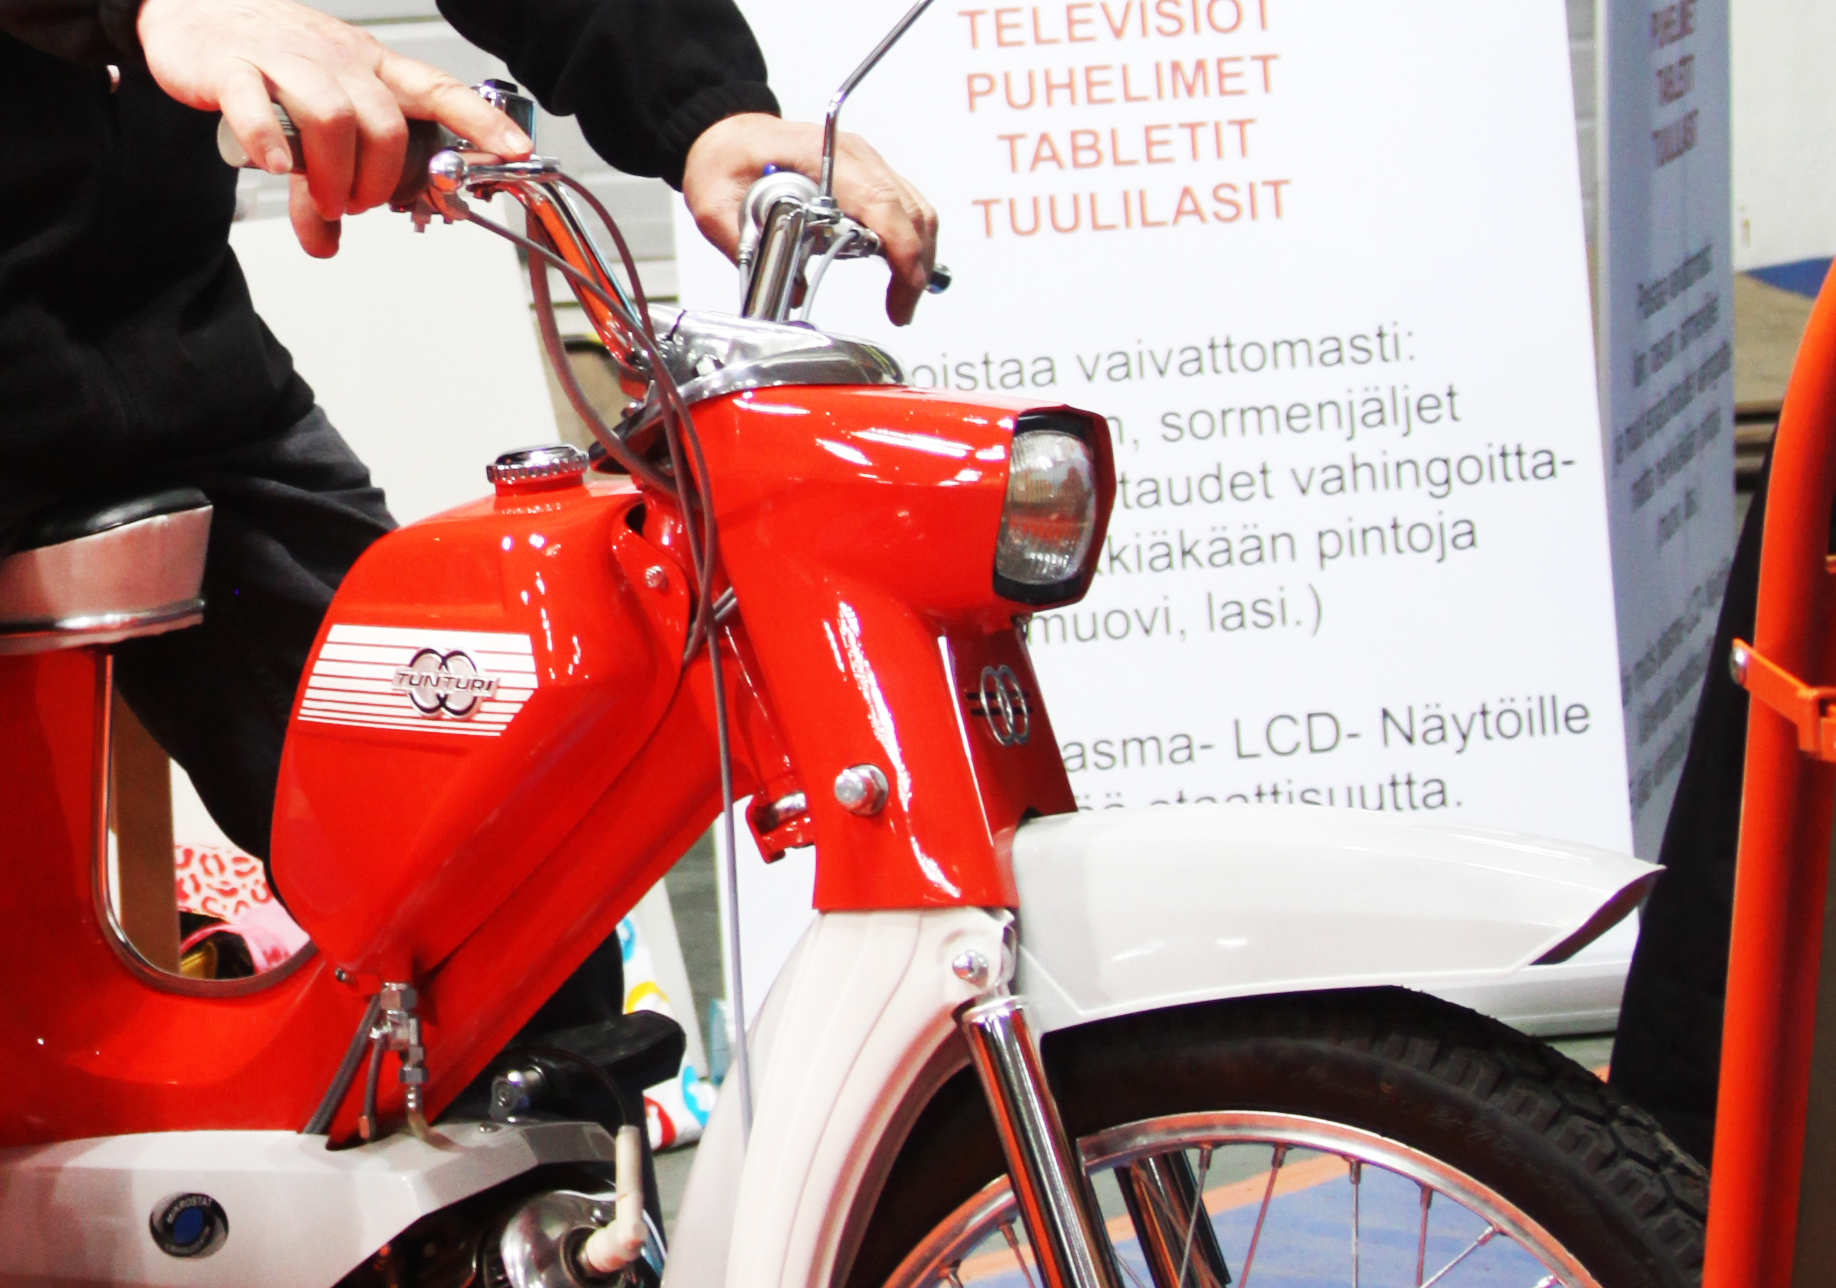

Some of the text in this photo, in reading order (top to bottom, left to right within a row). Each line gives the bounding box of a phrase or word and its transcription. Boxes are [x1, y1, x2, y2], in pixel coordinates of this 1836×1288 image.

[967, 54, 1281, 113] PUHELIMET
[998, 118, 1258, 175] TABLETIT
[972, 178, 1293, 239] TUULILASIT
[911, 325, 1417, 391] oistaa vaivattomasti:
[1160, 383, 1461, 445] sormenjäljet
[1117, 462, 1273, 511] taudet
[1290, 441, 1576, 499] vahingoitta-
[1317, 515, 1478, 569] pintoja
[1026, 586, 1325, 646] muovi, lasi.)
[398, 672, 494, 693] TUNTURI
[1063, 695, 1592, 775] asma- LCD- Näytöille
